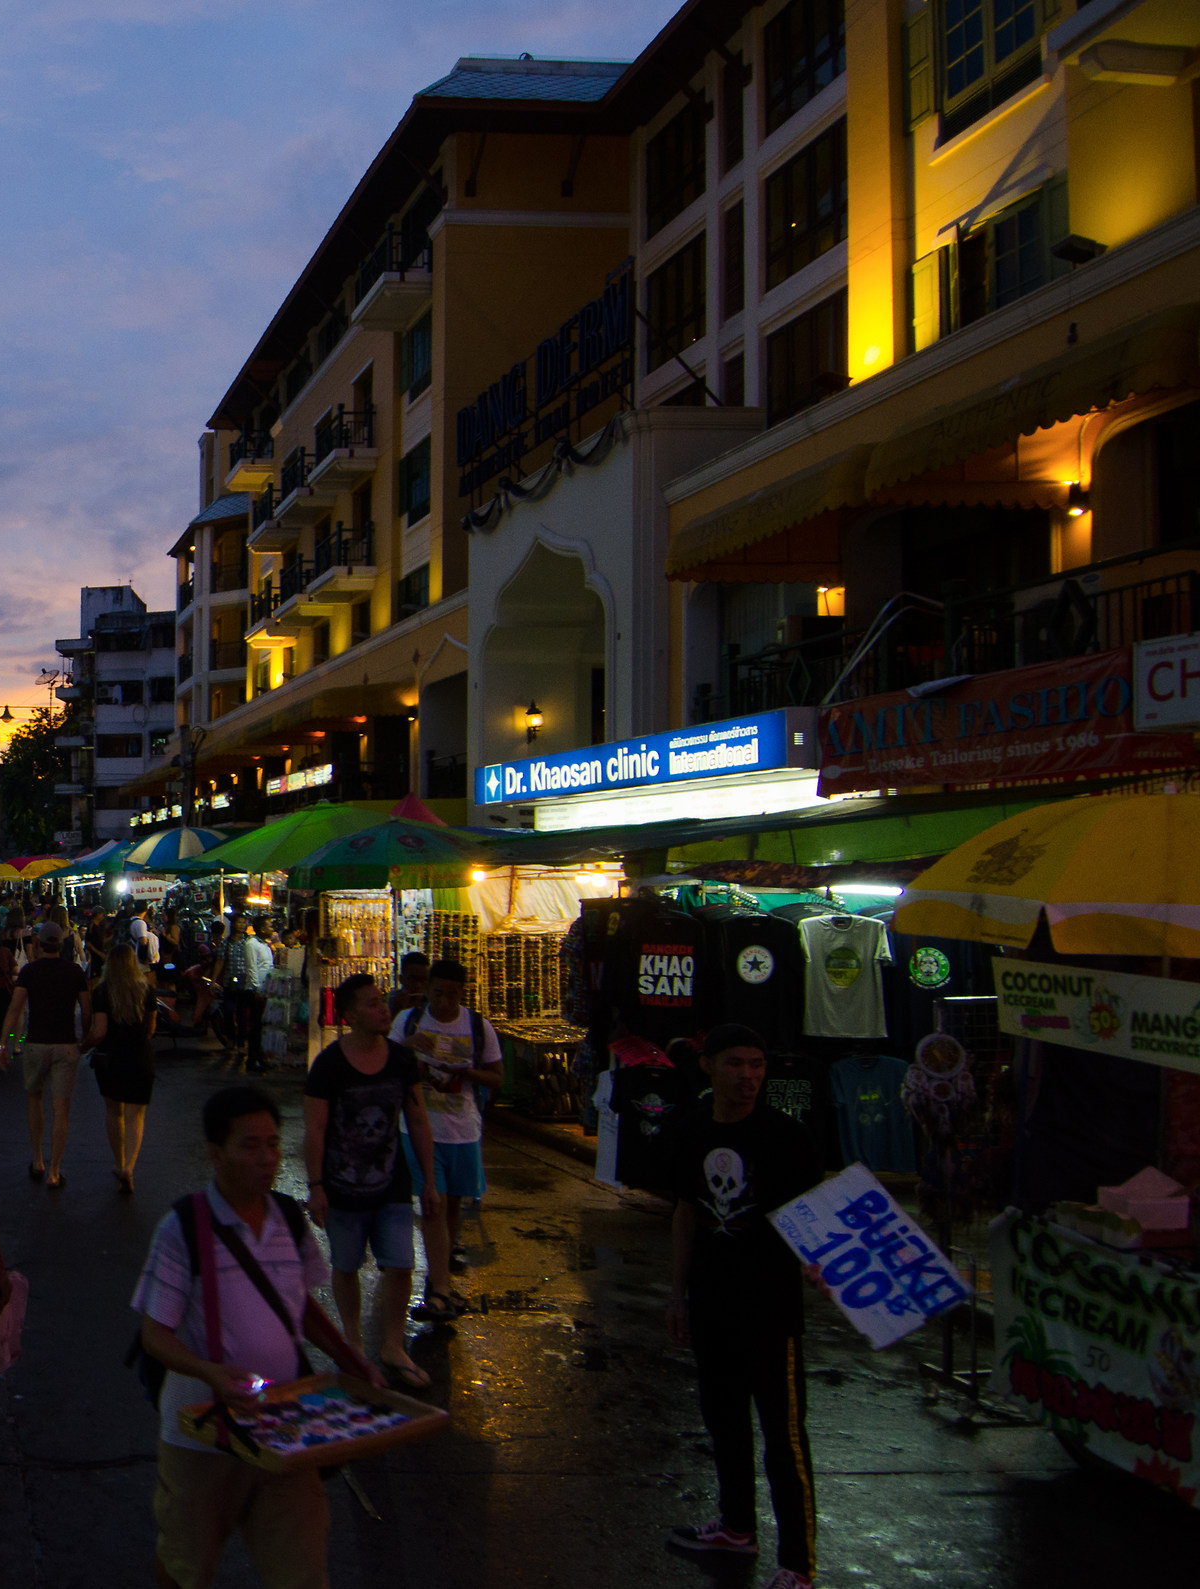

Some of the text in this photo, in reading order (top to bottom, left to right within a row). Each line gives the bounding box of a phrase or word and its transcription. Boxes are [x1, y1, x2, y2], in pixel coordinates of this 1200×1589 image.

[456, 266, 632, 467] DANG DERM
[956, 675, 1132, 740] FASHIO
[669, 738, 758, 775] International
[930, 745, 1001, 770] Tailoring
[1006, 739, 1050, 759] since
[1055, 730, 1100, 752] 1986
[505, 744, 660, 795] Dr. Khaosan clinic
[641, 944, 694, 955] BANGKOK
[639, 954, 694, 977] KHAO
[638, 975, 694, 996] SAN
[1001, 971, 1095, 997] COCONUT
[639, 994, 693, 1007] THAILAND
[1003, 994, 1056, 1010] ICECREAM
[766, 1079, 813, 1094] STAR
[798, 1232, 893, 1309] 100
[1084, 1344, 1112, 1372] 50
